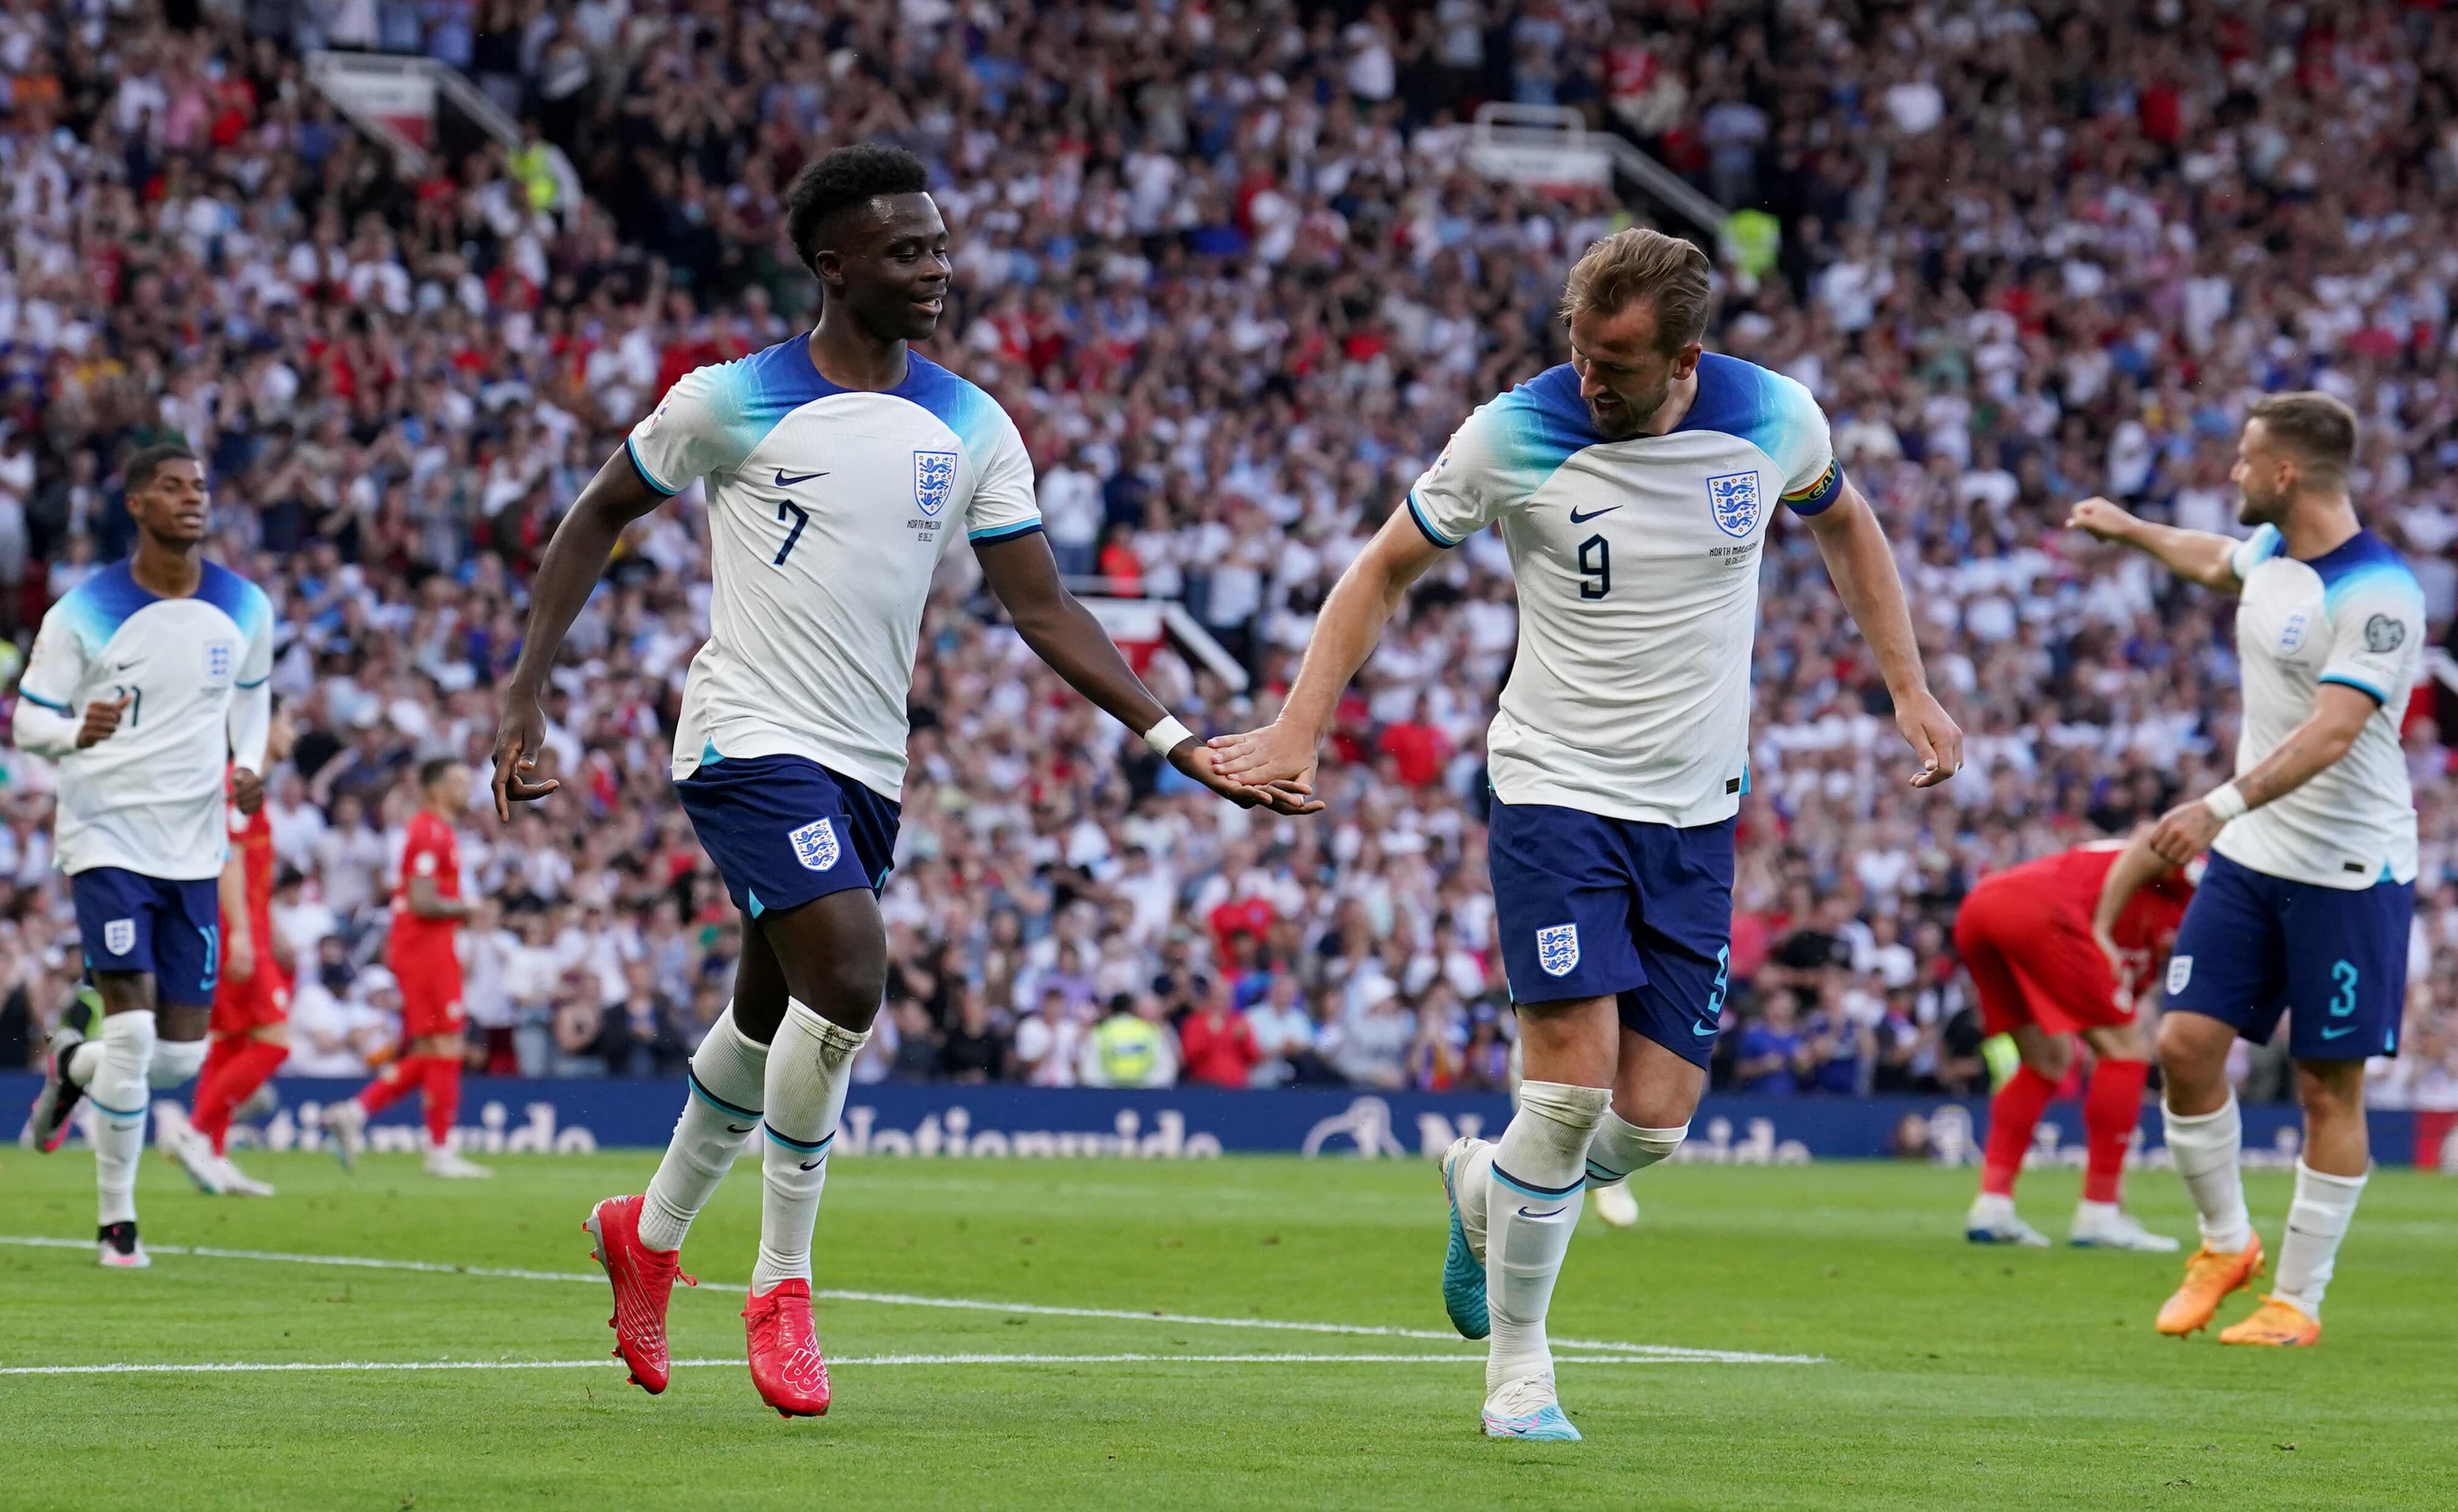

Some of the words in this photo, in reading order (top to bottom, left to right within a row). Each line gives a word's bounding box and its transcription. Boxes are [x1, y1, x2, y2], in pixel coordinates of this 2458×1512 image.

[773, 498, 809, 566] 7
[1709, 547, 1731, 557] NORTH
[1578, 533, 1611, 600] 9
[1707, 944, 1731, 1014] 9
[2330, 958, 2359, 1017] 3
